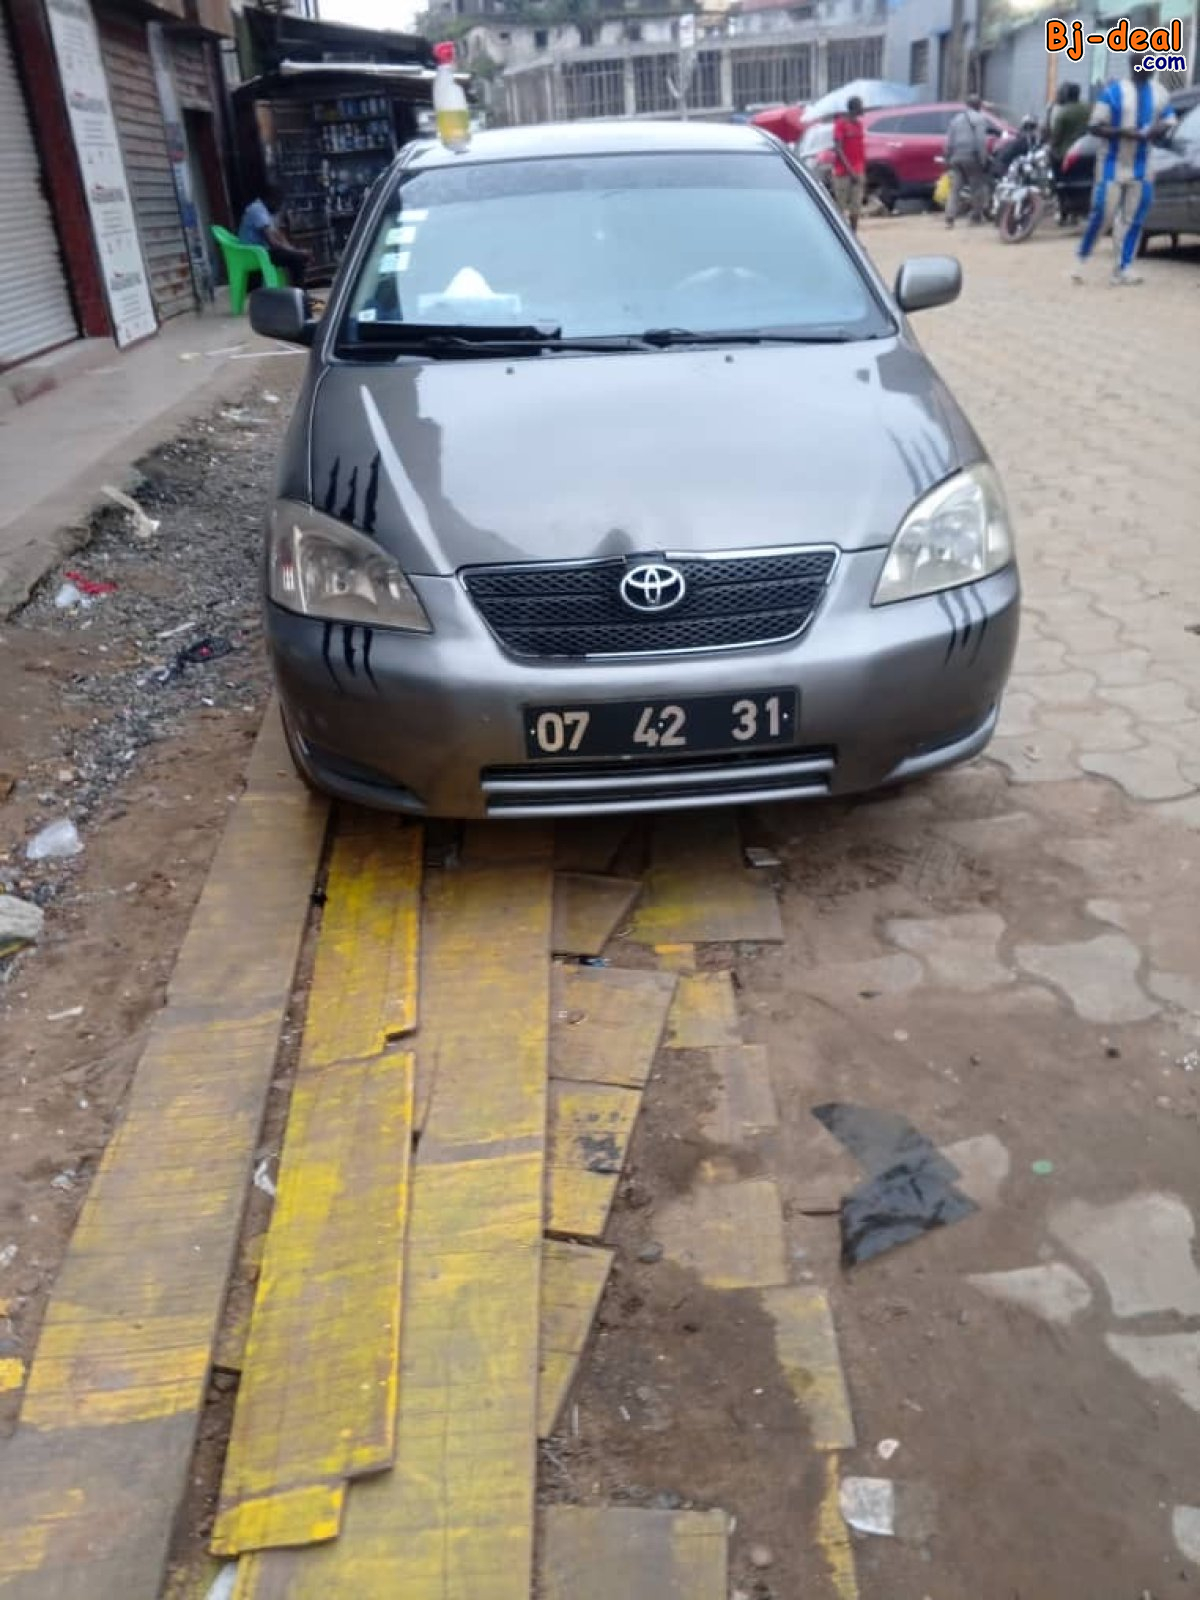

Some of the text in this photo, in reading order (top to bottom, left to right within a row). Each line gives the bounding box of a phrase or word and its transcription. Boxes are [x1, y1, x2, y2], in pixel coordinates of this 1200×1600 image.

[536, 696, 780, 752] 07 42 31
